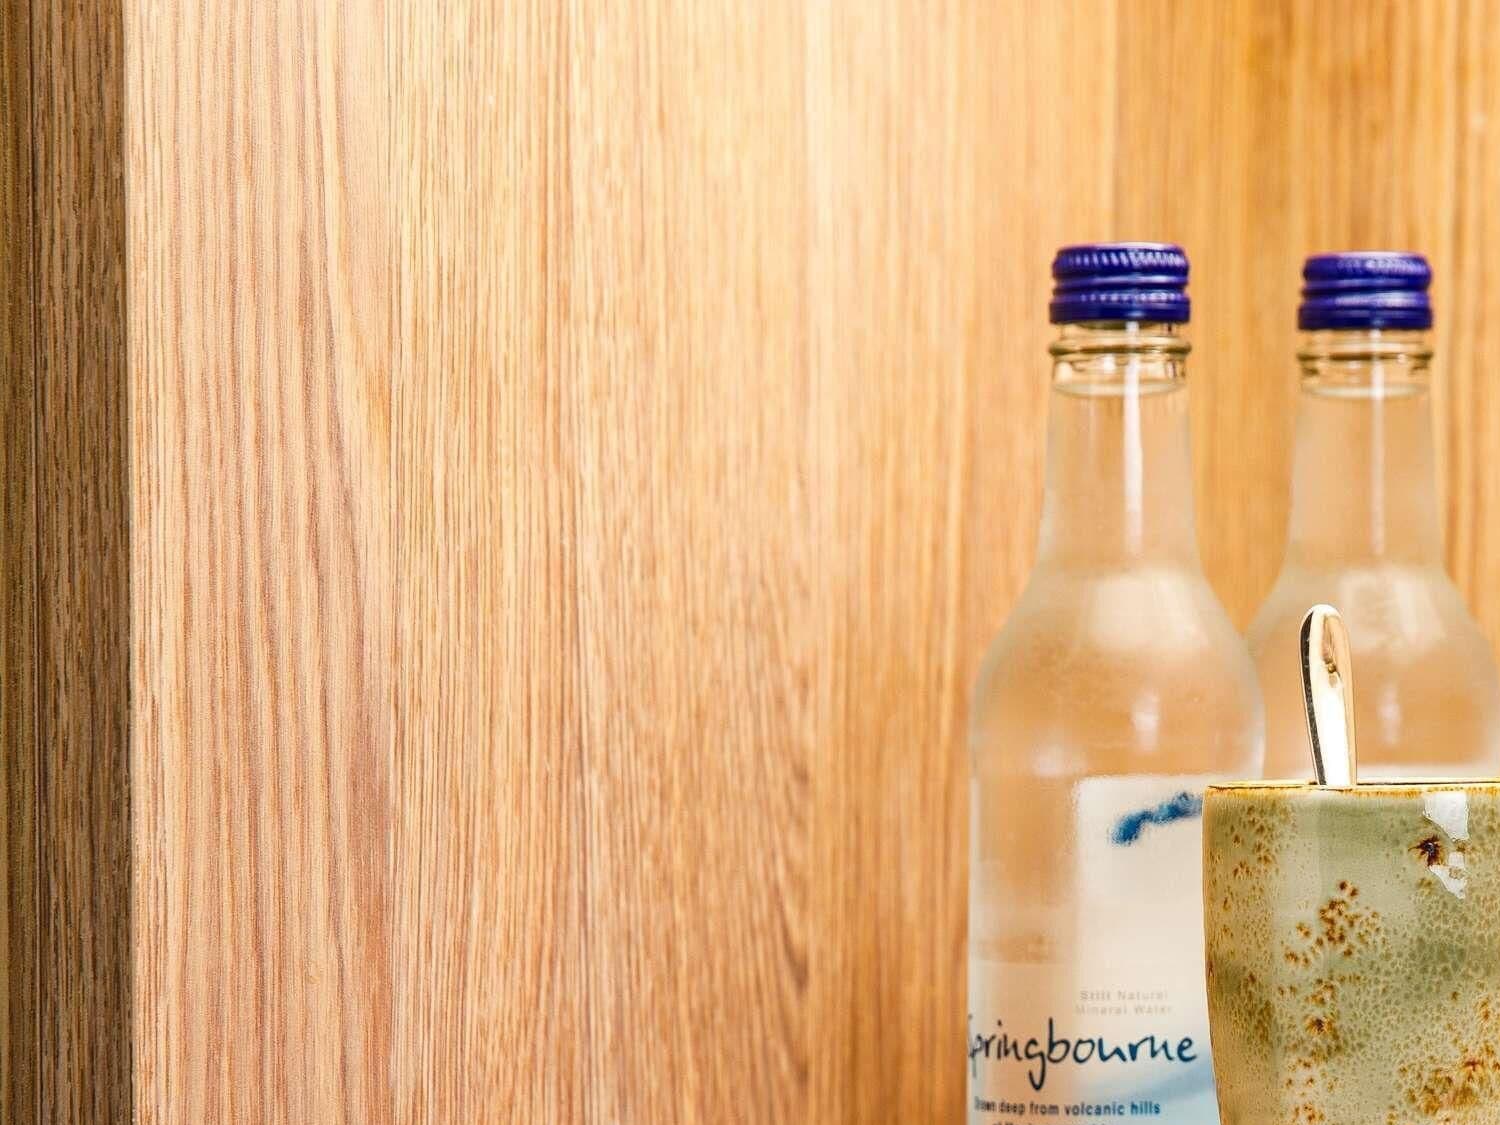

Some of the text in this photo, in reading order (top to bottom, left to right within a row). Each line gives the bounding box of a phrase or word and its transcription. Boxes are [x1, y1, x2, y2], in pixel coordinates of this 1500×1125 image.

[1118, 990, 1169, 1001] Natural
[1076, 1005, 1127, 1015] Mineral
[1000, 1101, 1025, 1116] deep
[1029, 1101, 1059, 1115] from
[1065, 1101, 1125, 1116] volcanic
[1130, 1100, 1161, 1115] hills
